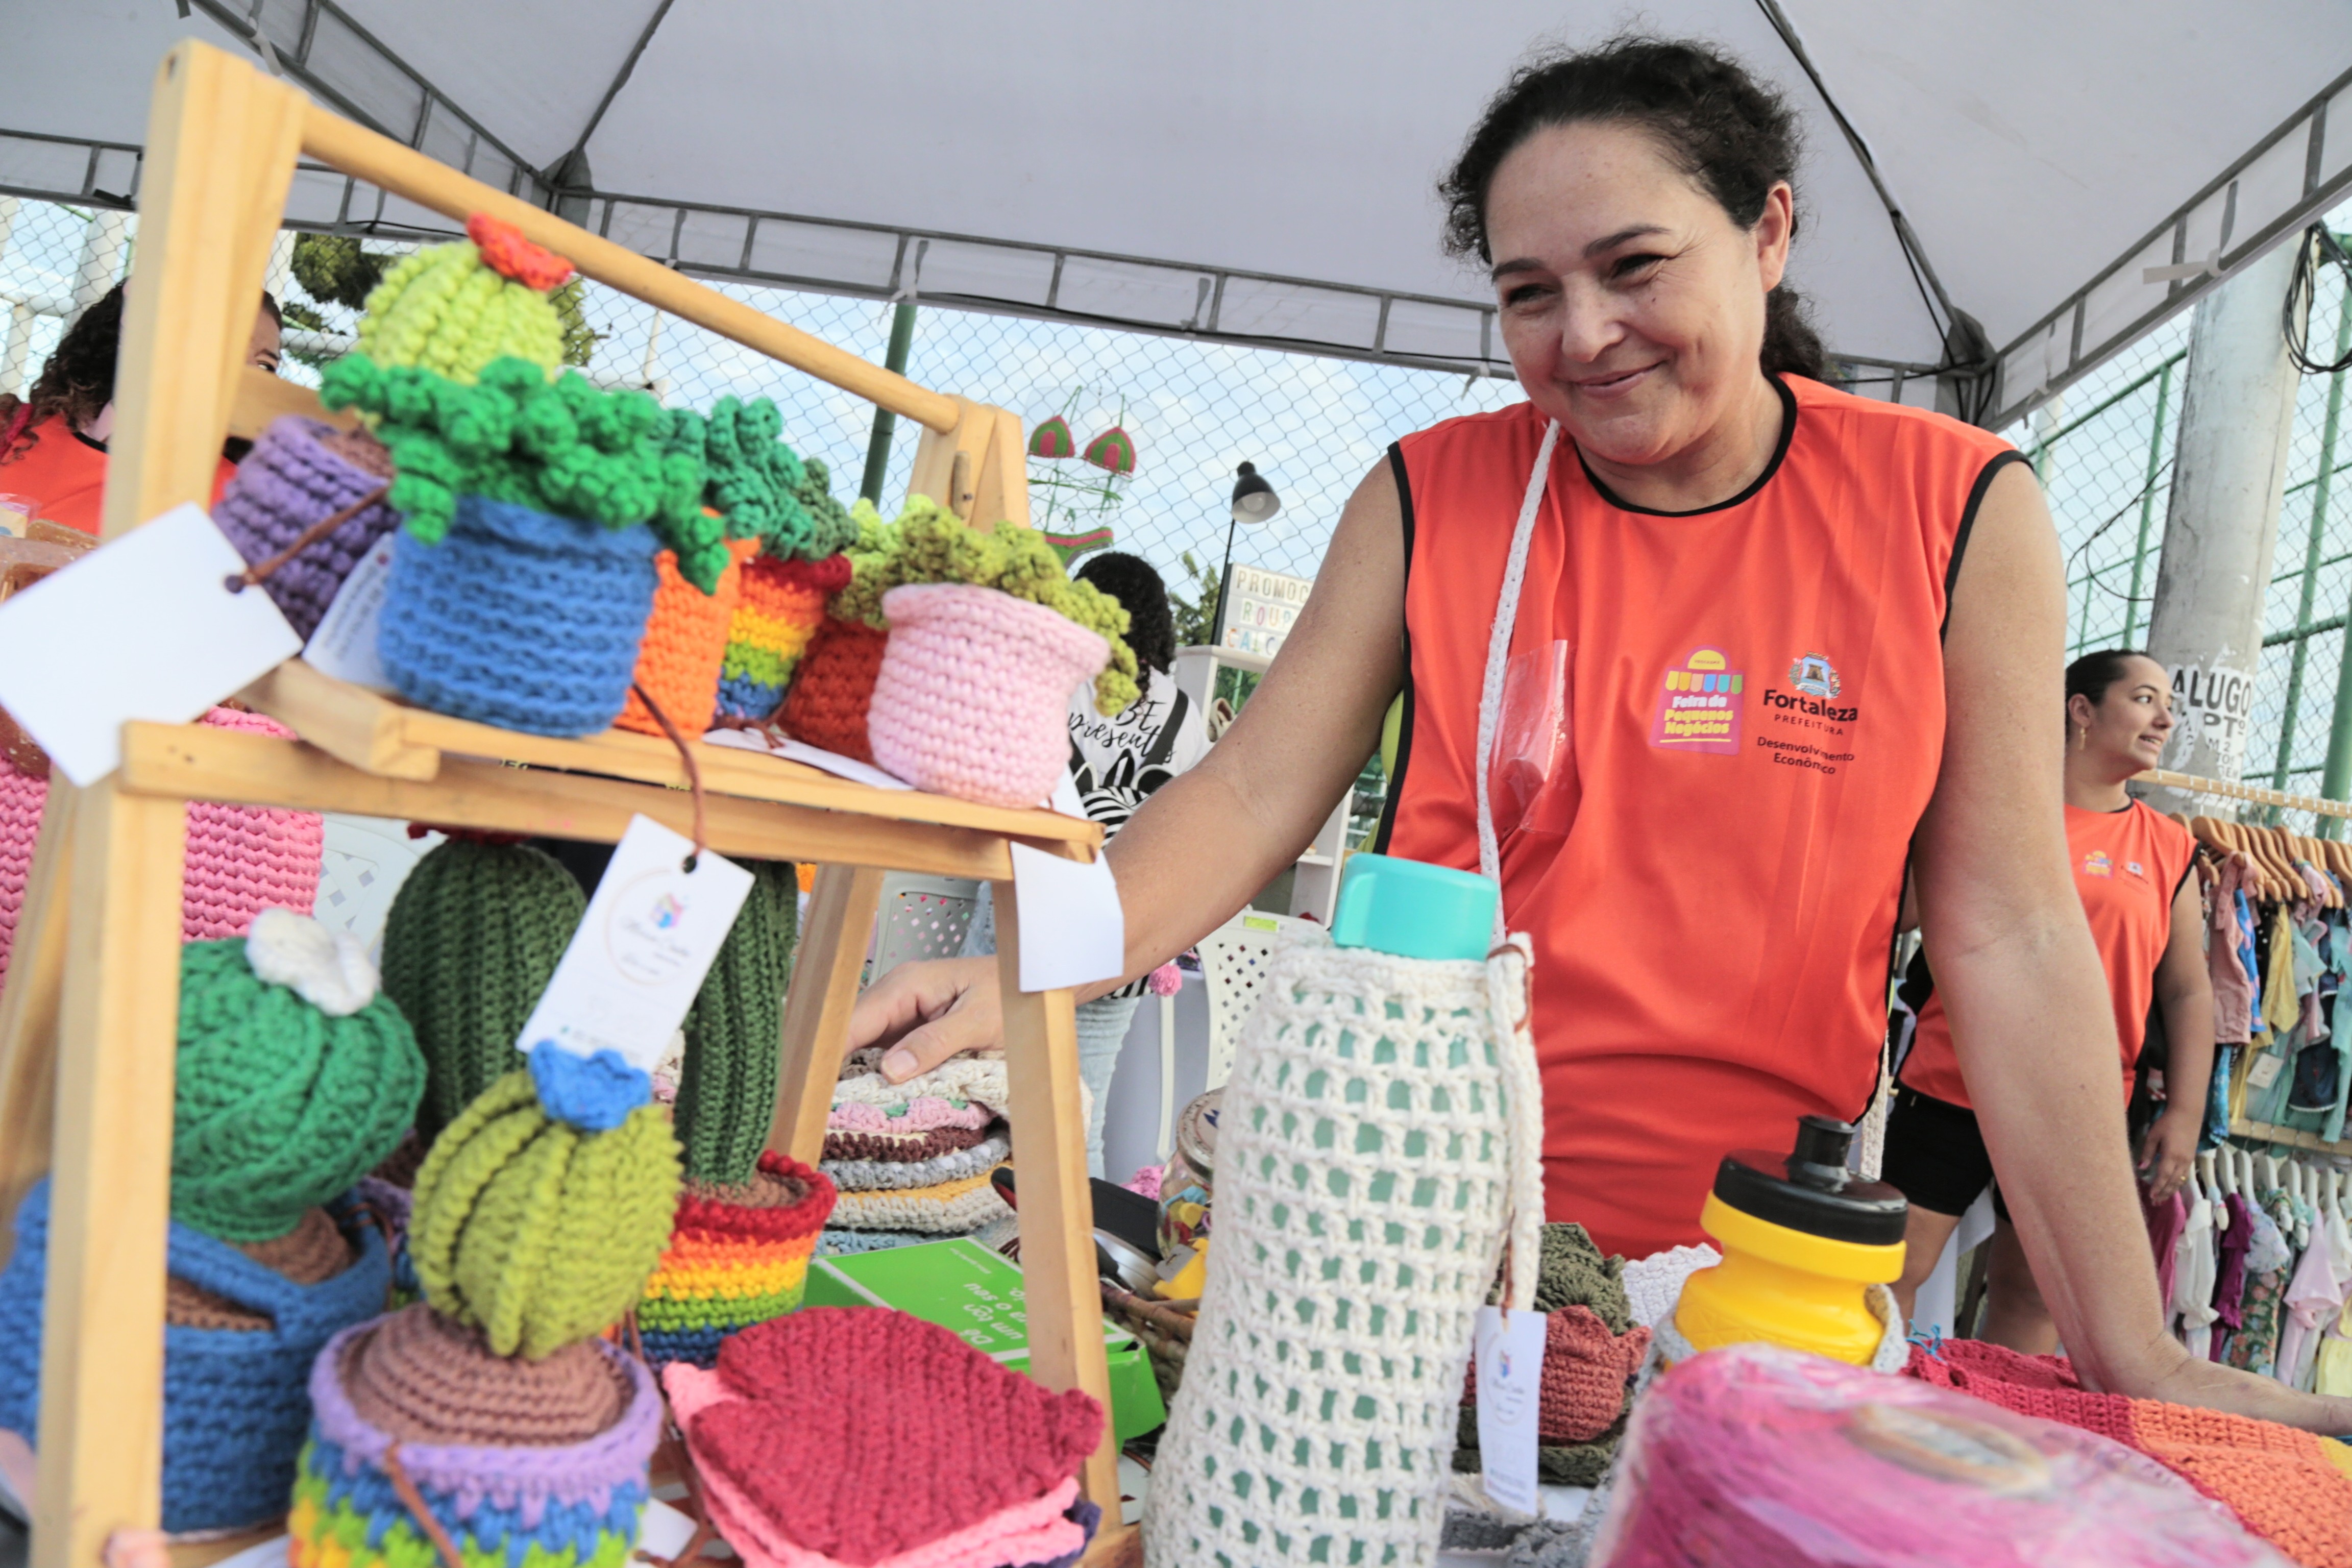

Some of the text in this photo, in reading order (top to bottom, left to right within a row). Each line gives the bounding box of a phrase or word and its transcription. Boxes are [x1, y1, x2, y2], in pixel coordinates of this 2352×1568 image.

[1236, 570, 1309, 603] PROMOC
[1243, 601, 1292, 628] ROUP
[1226, 628, 1276, 656] CALC
[1672, 695, 1727, 708] Feira de
[1763, 689, 1858, 722] Fortaleza
[2172, 669, 2252, 717] ALUGO
[1664, 709, 1734, 723] Pequenos
[1774, 714, 1844, 736] PREFEITURA
[1664, 721, 1730, 737] Negócios
[1757, 737, 1855, 762] Desenvolvmento
[1774, 752, 1836, 775] Econômco
